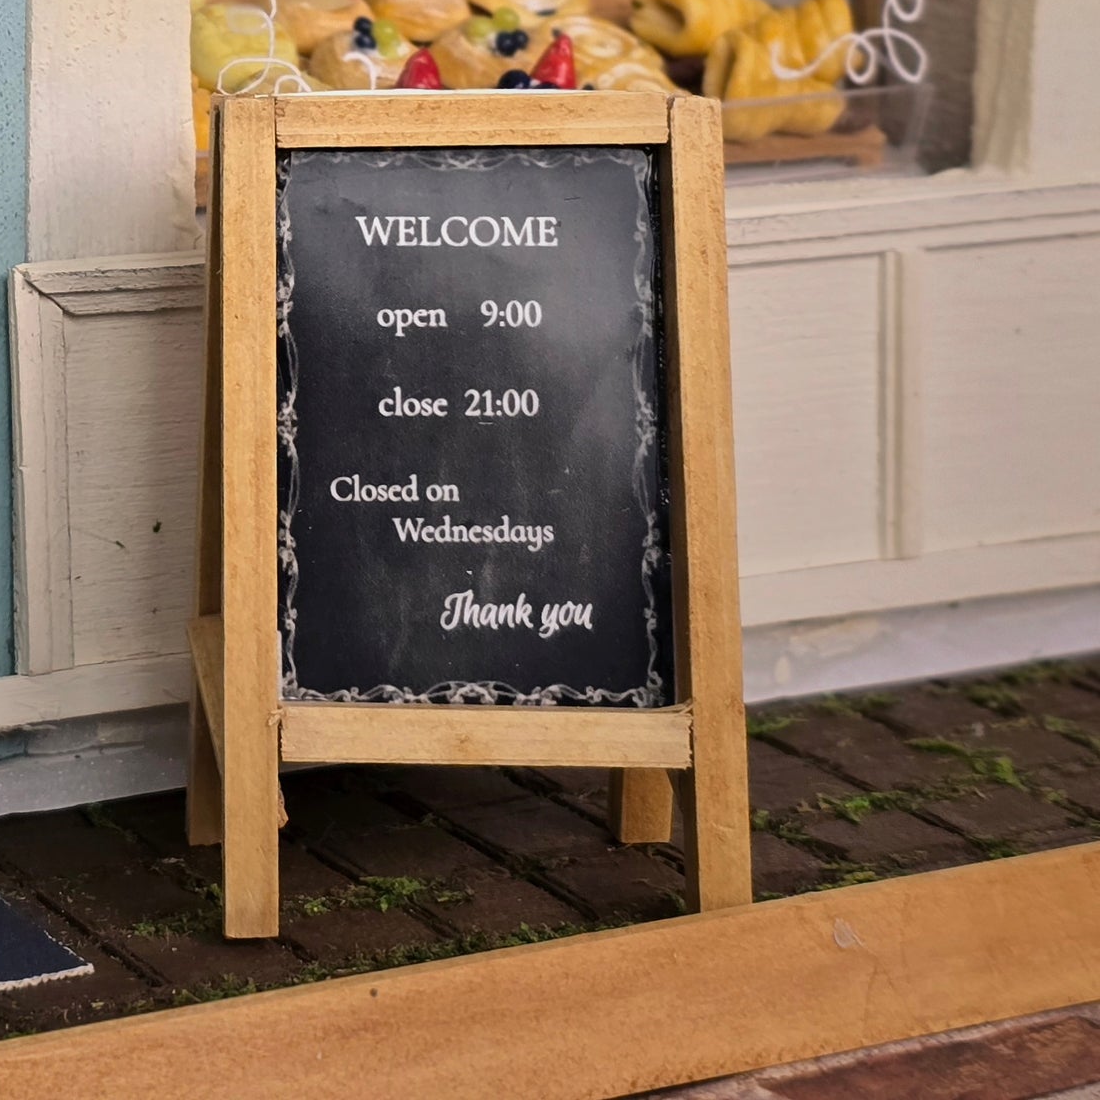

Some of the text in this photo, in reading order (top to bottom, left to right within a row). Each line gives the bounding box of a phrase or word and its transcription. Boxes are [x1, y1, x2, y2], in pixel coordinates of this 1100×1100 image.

[355, 216, 561, 248] WELCOME
[377, 300, 543, 337] open 9:00
[378, 387, 540, 418] close 21:00
[330, 474, 460, 503] Closed on
[392, 515, 555, 552] Wednesdays
[440, 589, 594, 639] Thank you
